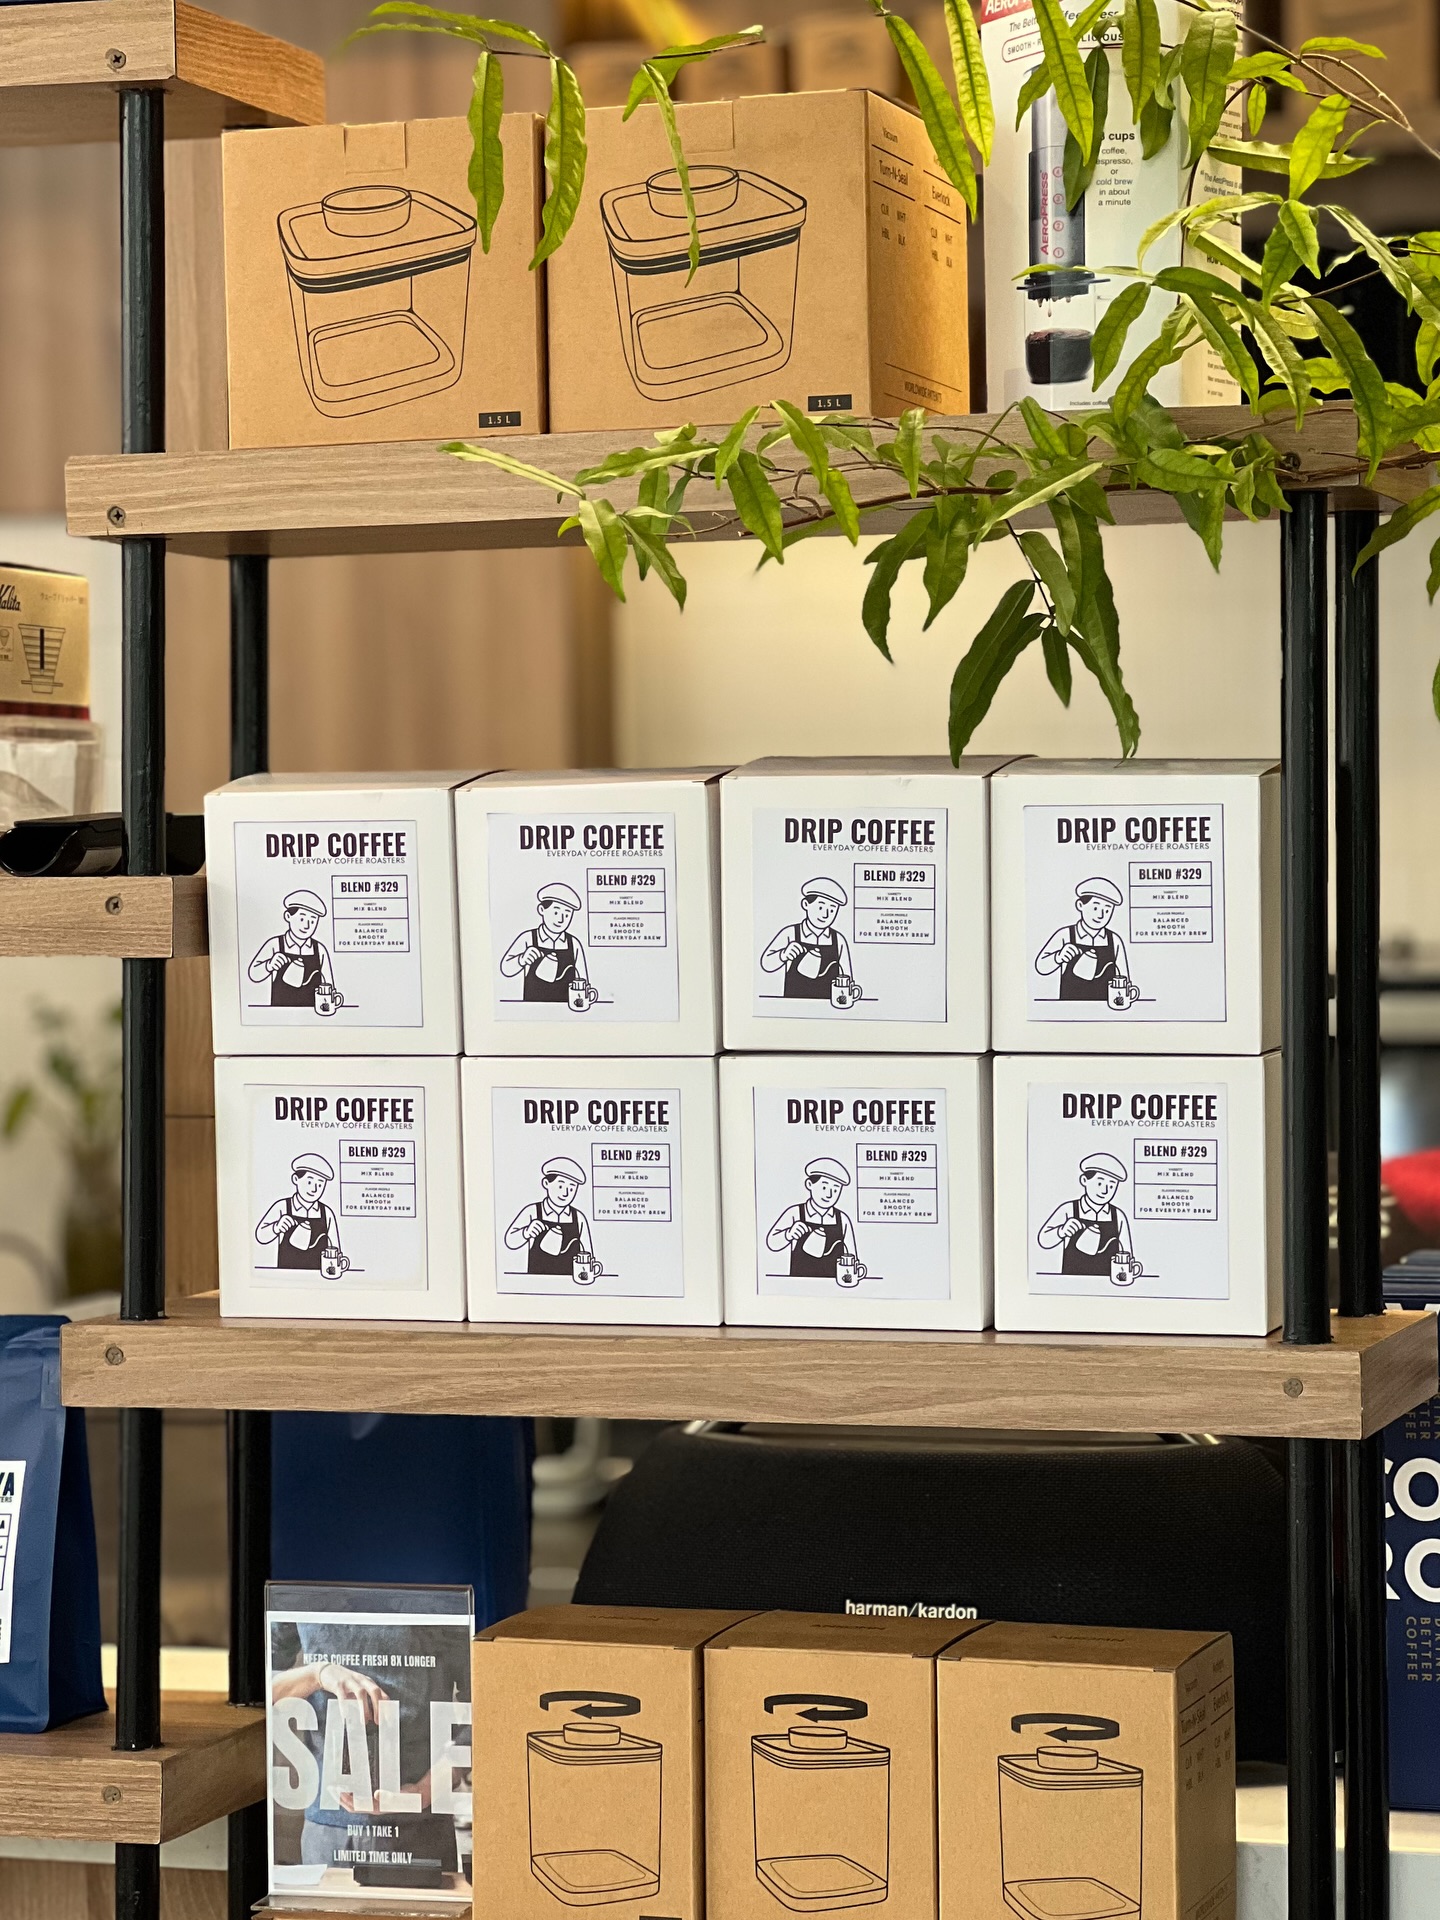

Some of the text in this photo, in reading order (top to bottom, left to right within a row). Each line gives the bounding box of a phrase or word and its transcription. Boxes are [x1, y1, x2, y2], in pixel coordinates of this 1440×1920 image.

[1010, 22, 1021, 32] The
[1008, 40, 1032, 55] SMOOTH
[1108, 132, 1135, 142] cups
[879, 160, 908, 186] Turn-N-Seal
[932, 186, 950, 207] Everlock
[1040, 172, 1049, 255] AEROPRESS
[818, 398, 841, 408] 1.5 L
[488, 415, 510, 424] 1.5 L
[520, 825, 664, 850] DRIP COFFEE
[784, 818, 936, 845] DRIP COFFEE
[1057, 817, 1212, 843] DRIP COFFEE
[266, 832, 406, 857] DRIP COFFEE
[596, 875, 656, 886] BLEND #329
[863, 870, 926, 882] BLEND #329
[1139, 868, 1202, 880] BLEND #329
[341, 881, 398, 892] BLEND #329
[275, 1097, 414, 1122] DRIP COFFEE
[524, 1100, 669, 1125] DRIP COFFEE
[787, 1099, 936, 1125] DRIP COFFEE
[1062, 1093, 1218, 1120] DRIP COFFEE
[348, 1146, 406, 1158] BLEND #329
[601, 1150, 661, 1161] BLEND #329
[866, 1150, 927, 1162] BLEND #329
[1144, 1145, 1208, 1158] BLEND #329
[846, 1599, 978, 1619] harman/kardon
[1406, 1616, 1418, 1681] COFFEE
[1420, 1617, 1432, 1681] BETTER
[330, 1654, 360, 1665] COFFEE
[362, 1654, 388, 1666] FRESH
[390, 1655, 402, 1666] 8X
[404, 1656, 436, 1667] LONGER
[272, 1696, 472, 1814] SALE
[347, 1825, 399, 1838] BUY 1 TAKE 1
[334, 1850, 412, 1864] LIMITED TIME ONLY
